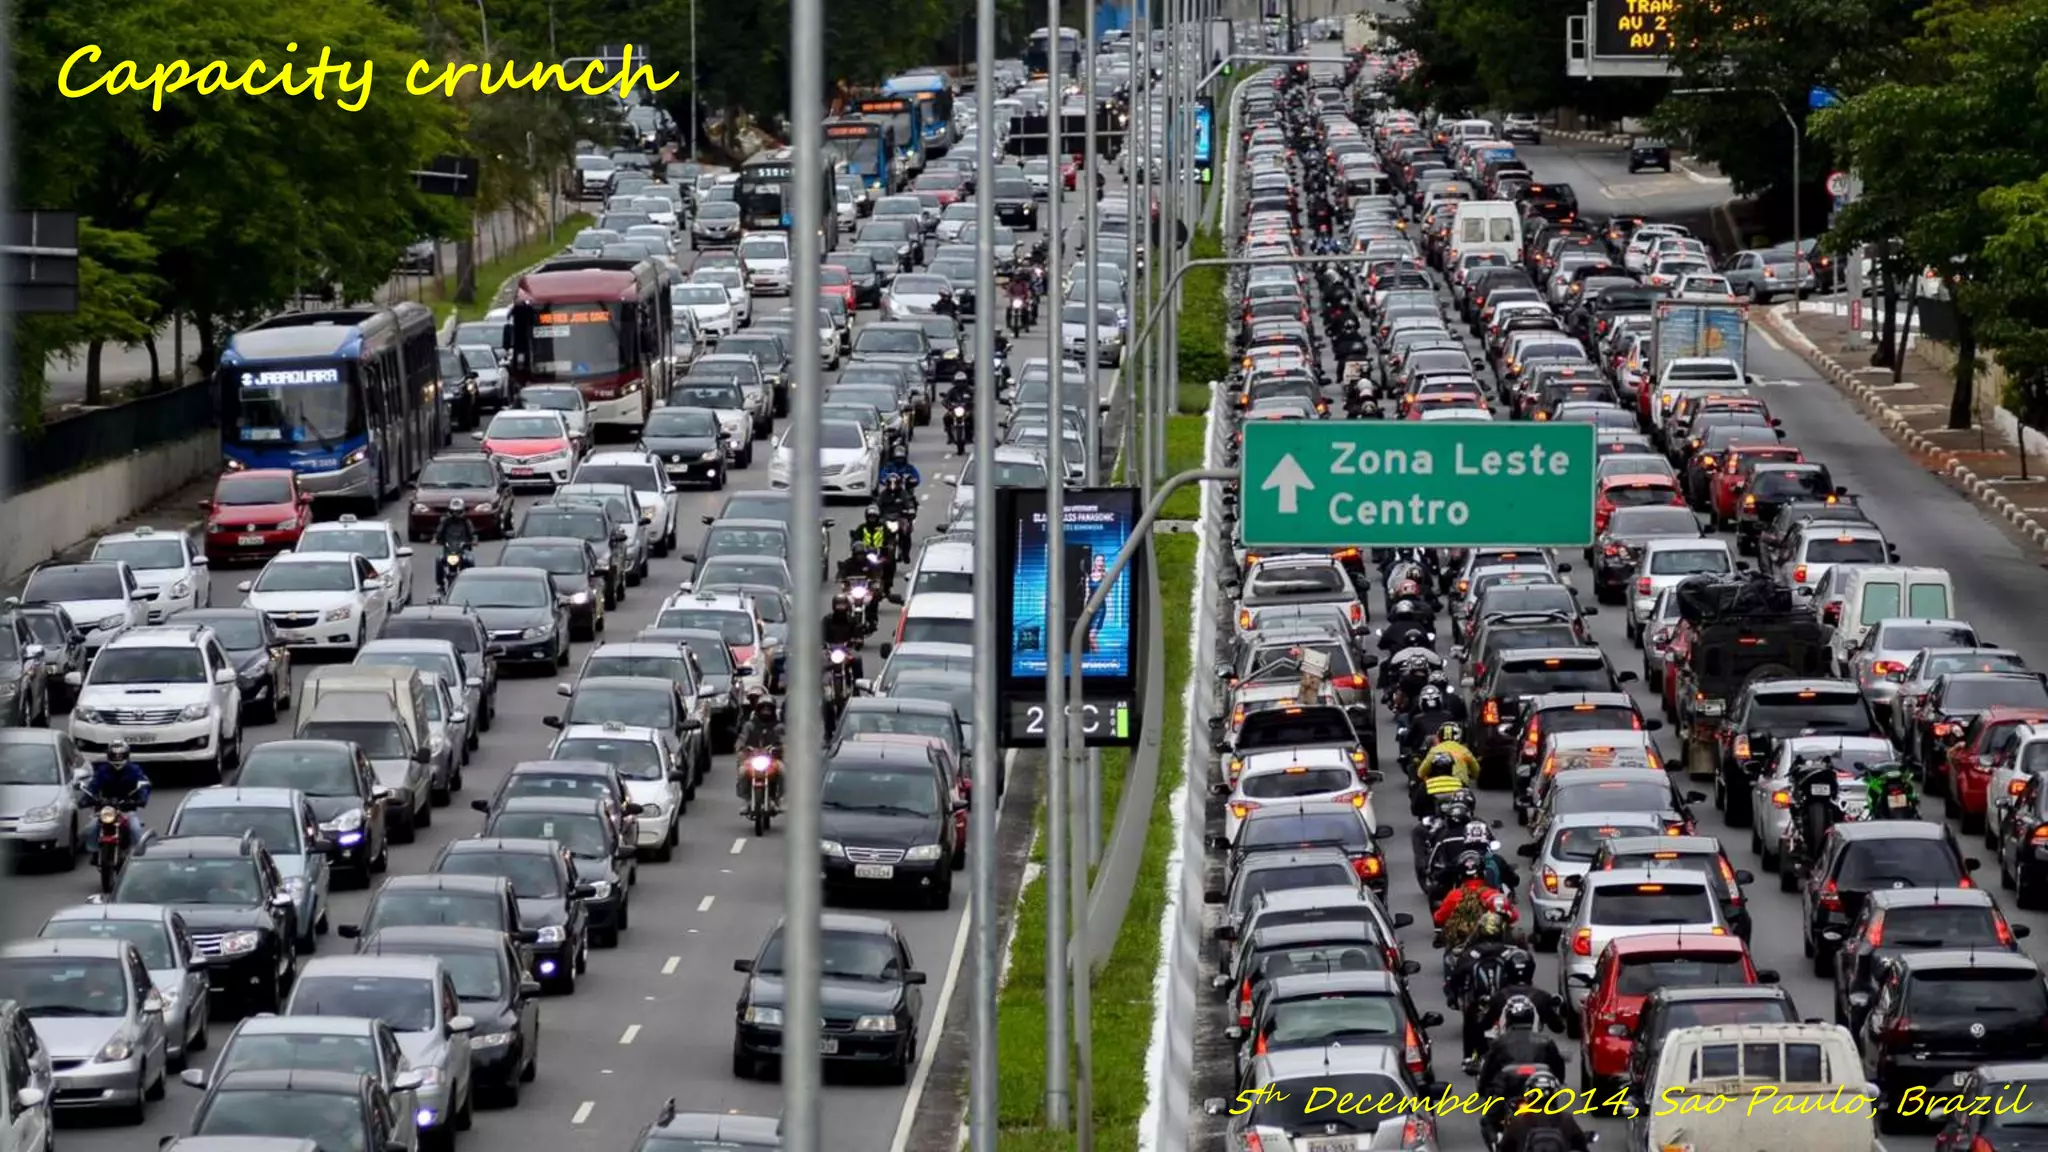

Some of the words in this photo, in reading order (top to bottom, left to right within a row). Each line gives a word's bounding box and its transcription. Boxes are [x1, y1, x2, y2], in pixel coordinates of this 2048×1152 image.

[1618, 15, 1643, 31] AV
[1630, 32, 1655, 48] AV
[255, 369, 338, 386] JABAQUARA
[1330, 442, 1433, 475] Zona
[1455, 443, 1570, 475] Leste
[1329, 493, 1470, 525] Centro
